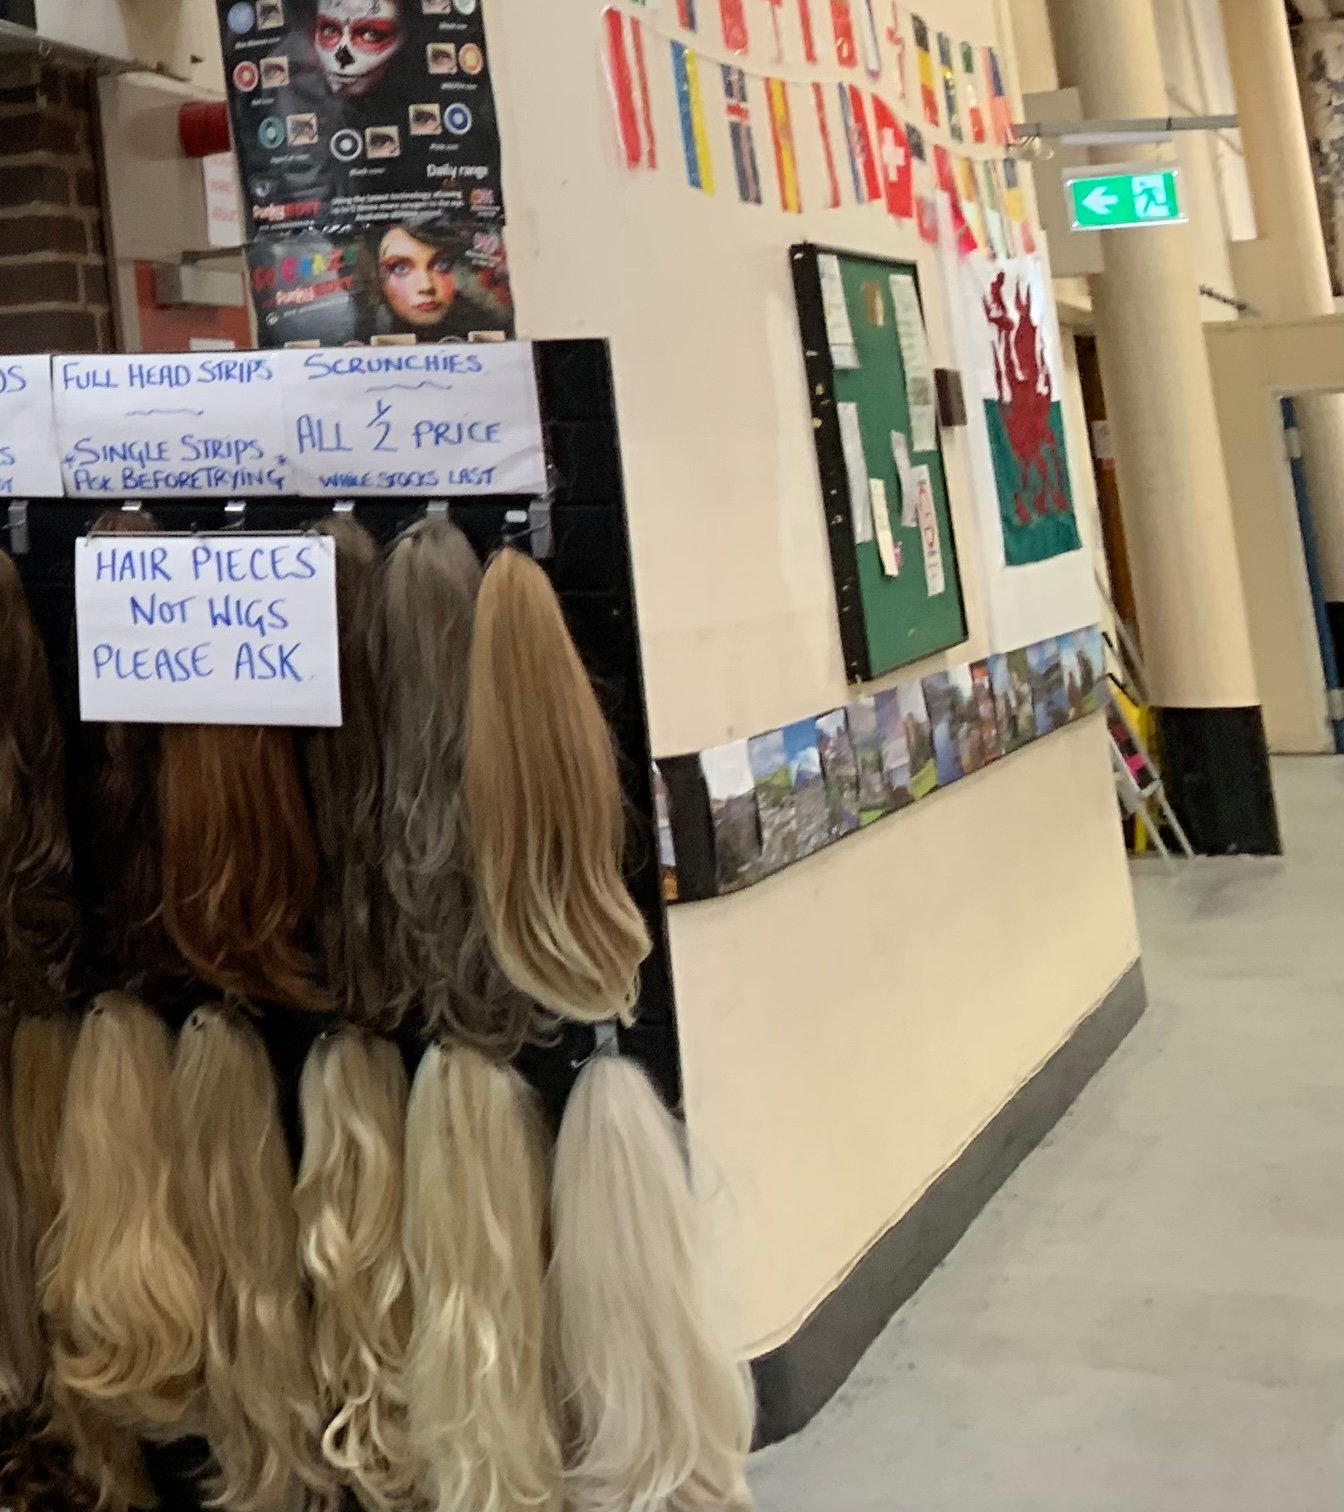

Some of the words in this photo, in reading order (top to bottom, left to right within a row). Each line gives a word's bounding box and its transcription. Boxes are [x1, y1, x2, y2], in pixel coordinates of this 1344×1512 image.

[62, 361, 120, 391] FULL
[127, 362, 192, 389] HEAD
[197, 357, 274, 384] STRIPS
[303, 350, 484, 381] SCRUNCHIES
[74, 437, 171, 470] SINGLE
[180, 433, 265, 466] STRIPS
[296, 413, 353, 455] ALL
[412, 418, 502, 450] PRICE
[121, 465, 199, 490] BEFORE
[197, 465, 290, 490] TRYING
[448, 465, 498, 487] LAST
[96, 546, 173, 582] HAIR
[191, 544, 317, 582] PIECES
[129, 592, 197, 626] NOT
[208, 593, 290, 639] WIGS
[92, 640, 215, 684] PLEASE
[234, 641, 305, 683] ASK
